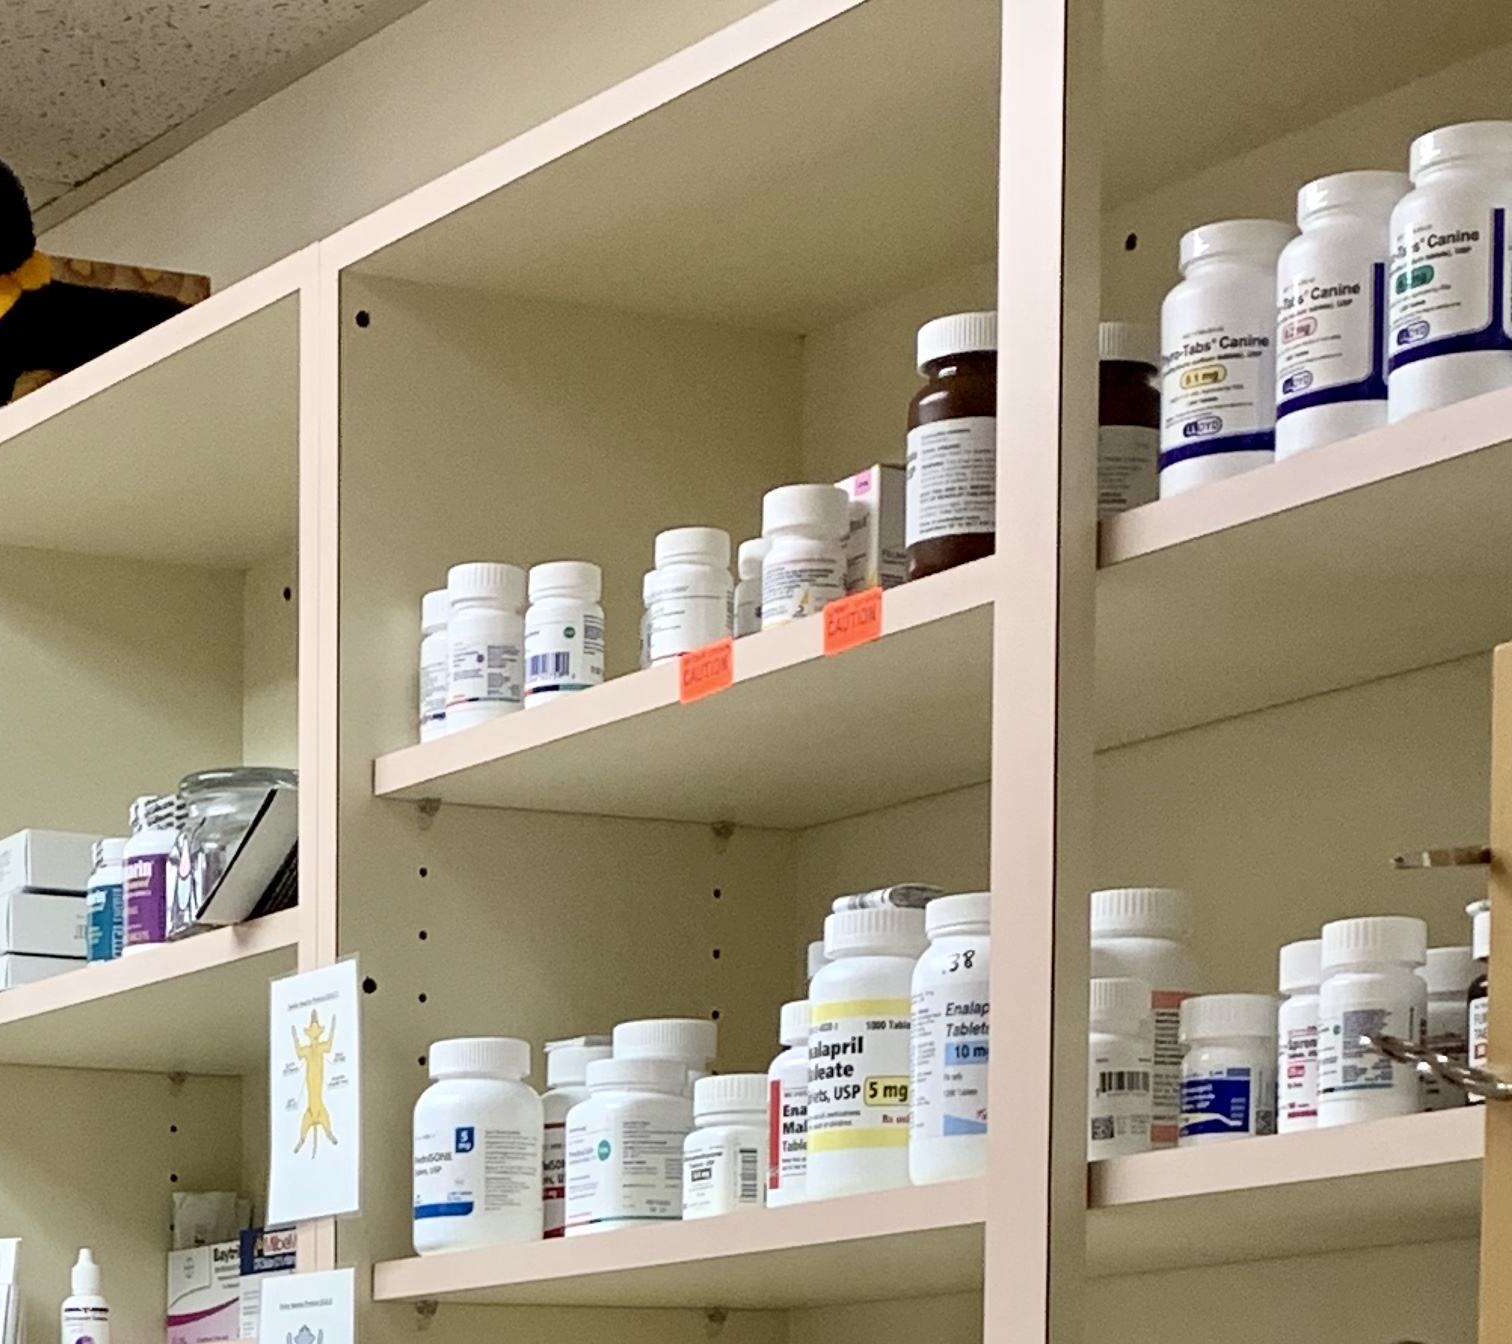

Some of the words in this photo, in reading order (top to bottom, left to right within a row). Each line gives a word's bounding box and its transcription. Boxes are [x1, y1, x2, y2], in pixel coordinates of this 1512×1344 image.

[1427, 230, 1480, 248] Canine
[1311, 281, 1361, 300] Canine
[1219, 335, 1270, 349] Canine
[827, 604, 877, 636] CAUTION
[682, 655, 728, 686] CAUTION
[945, 1002, 989, 1017] Enalap
[955, 1045, 970, 1058] 10
[834, 1084, 861, 1100] USP
[869, 1082, 878, 1098] 5
[883, 1083, 908, 1101] mg
[459, 1130, 468, 1142] 5
[782, 1140, 807, 1152] Table
